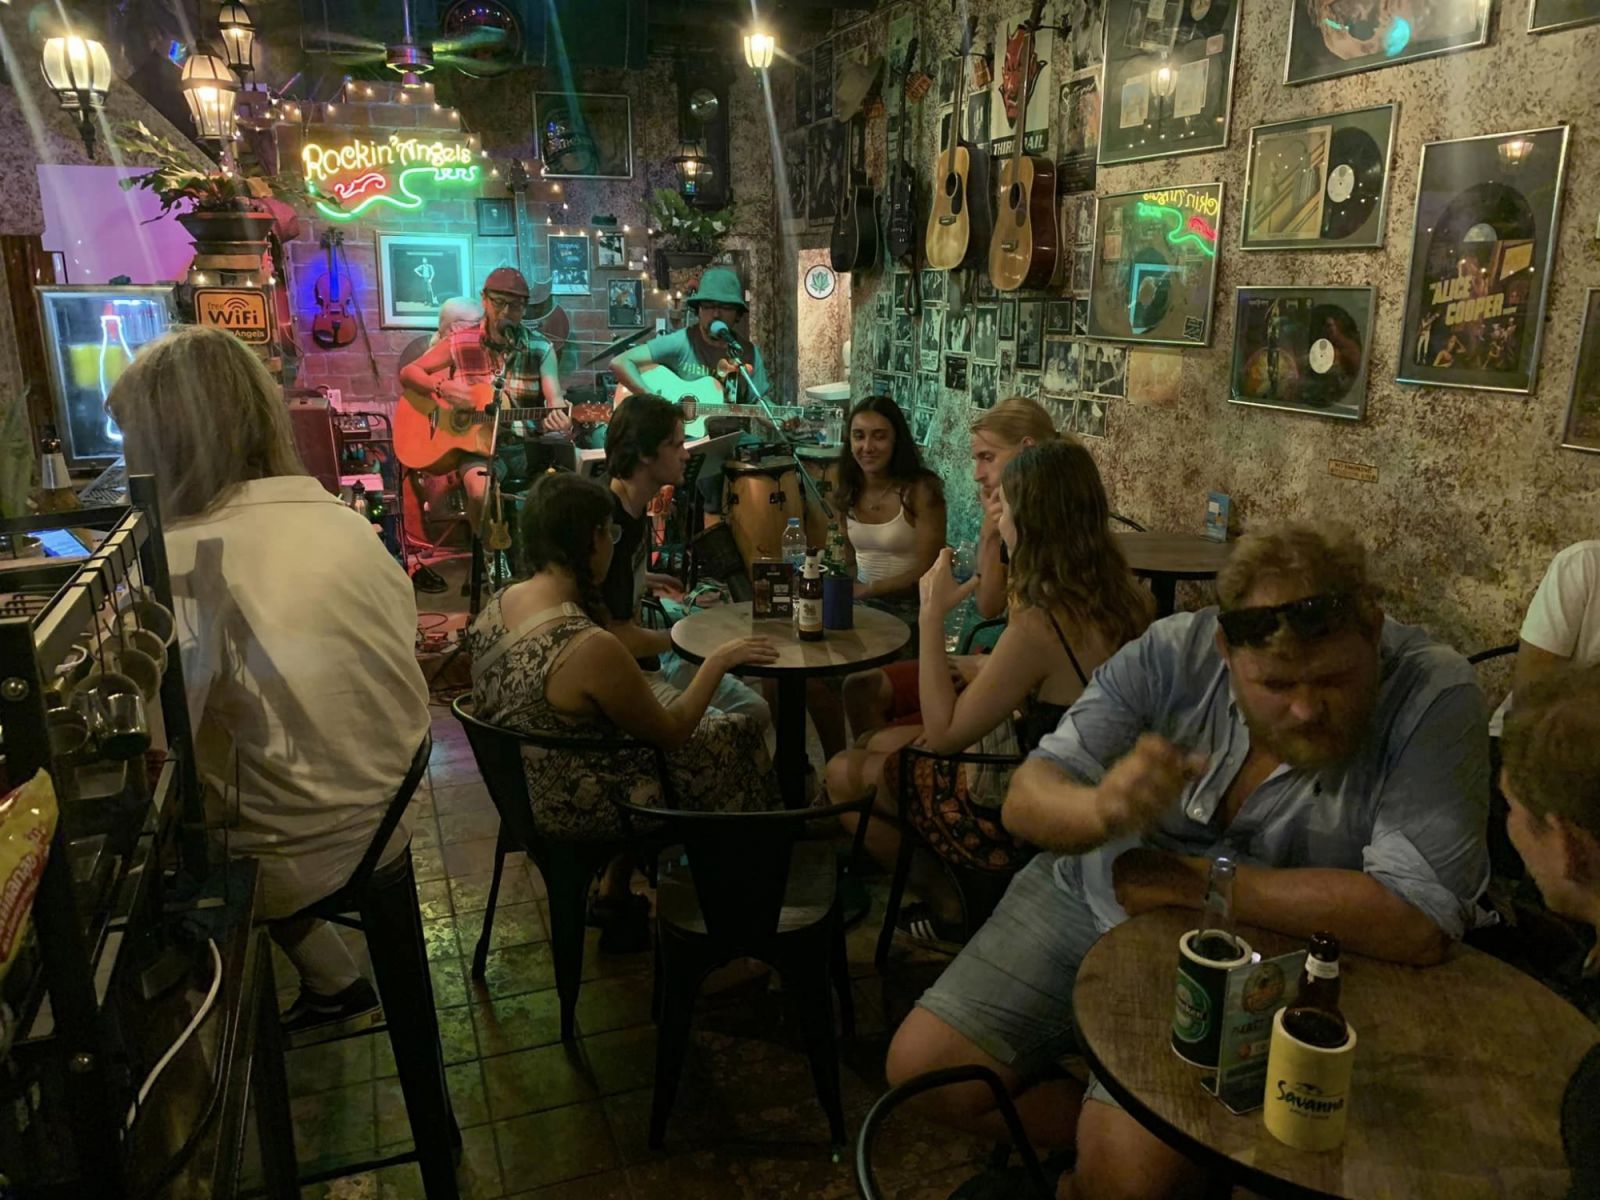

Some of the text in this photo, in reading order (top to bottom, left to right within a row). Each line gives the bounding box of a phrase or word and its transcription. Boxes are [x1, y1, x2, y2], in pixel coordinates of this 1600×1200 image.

[302, 135, 472, 181] Rockin' Angels
[1430, 275, 1473, 305] ALICE
[208, 310, 258, 325] WiFi
[1445, 293, 1507, 325] COOPER
